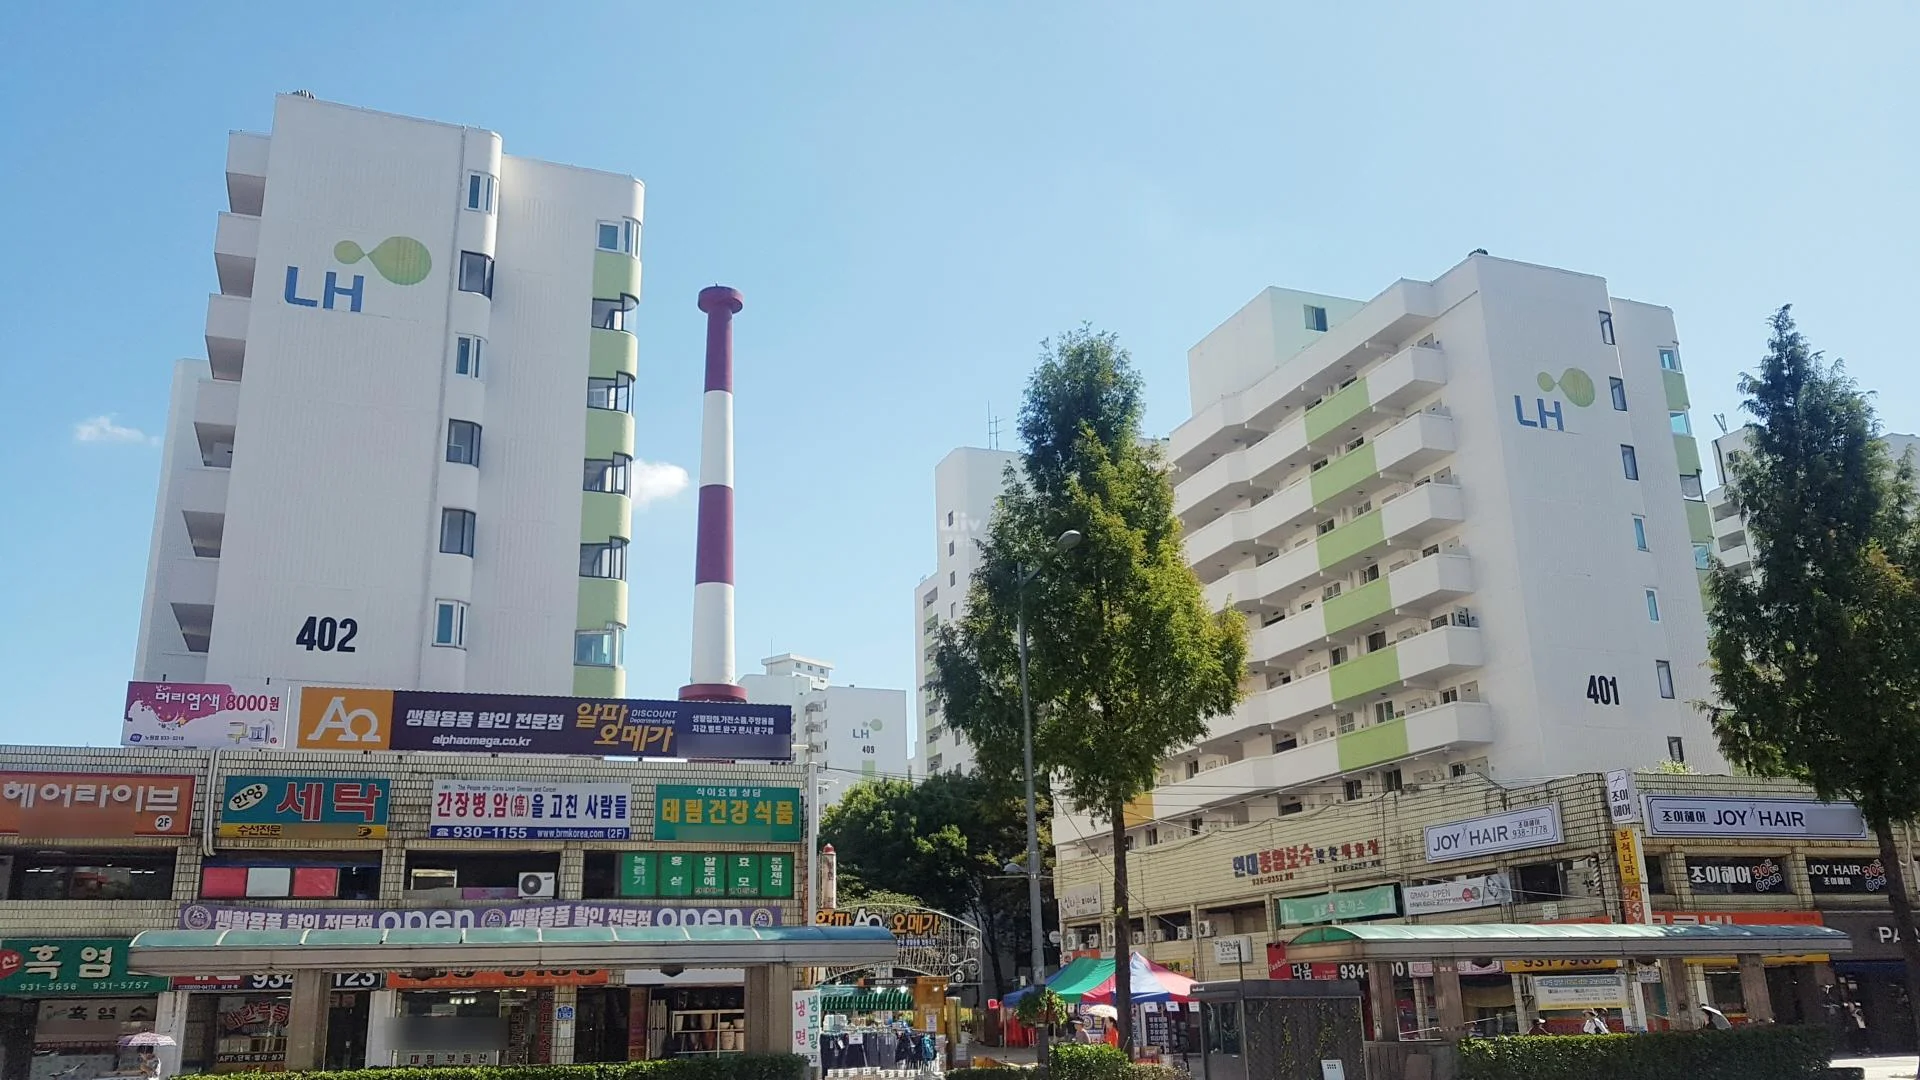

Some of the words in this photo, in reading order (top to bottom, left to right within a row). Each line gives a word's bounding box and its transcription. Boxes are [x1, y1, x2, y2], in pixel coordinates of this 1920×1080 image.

[285, 266, 365, 312] LH
[1514, 395, 1564, 432] LH
[296, 616, 358, 652] 402
[155, 691, 221, 711] 머리염색
[226, 694, 279, 711] 8000원
[1587, 675, 1620, 705] 401
[406, 709, 474, 728] 생활용품
[478, 711, 511, 729] 할인
[516, 713, 564, 731] 전문점
[577, 703, 629, 729] 알파
[631, 708, 677, 718] DISCOUNT
[432, 735, 532, 746] alphaomega.co.kr
[594, 723, 673, 752] 오메가
[852, 729, 869, 739] LH
[3, 782, 180, 812] 헤어라이브
[232, 785, 263, 808] 한양
[276, 782, 382, 822] 세탁
[550, 794, 577, 818] 고친
[585, 794, 627, 819] 사람들
[1611, 789, 1628, 801] 조이
[1613, 804, 1631, 817] 헤어
[1662, 810, 1706, 823] 조이헤어
[1713, 810, 1747, 825] JOY
[1759, 811, 1806, 827] HAIR
[157, 817, 170, 828] 2F
[238, 825, 281, 836] 수선전문
[453, 827, 527, 838] 930-1155
[607, 828, 626, 839] (2F)
[1433, 833, 1460, 852] JOY
[1469, 825, 1509, 846] HAIR
[670, 856, 683, 886] 홍삼
[703, 857, 716, 886] 알로에
[738, 857, 750, 887] 효모
[1690, 866, 1751, 884] 조이헤어
[1808, 864, 1829, 876] JOY
[1834, 864, 1862, 876] HAIR
[509, 905, 571, 928] 생활용품
[891, 912, 940, 934] 오메가
[92, 981, 149, 991] 931-5757
[795, 1000, 805, 1046] 냉면
